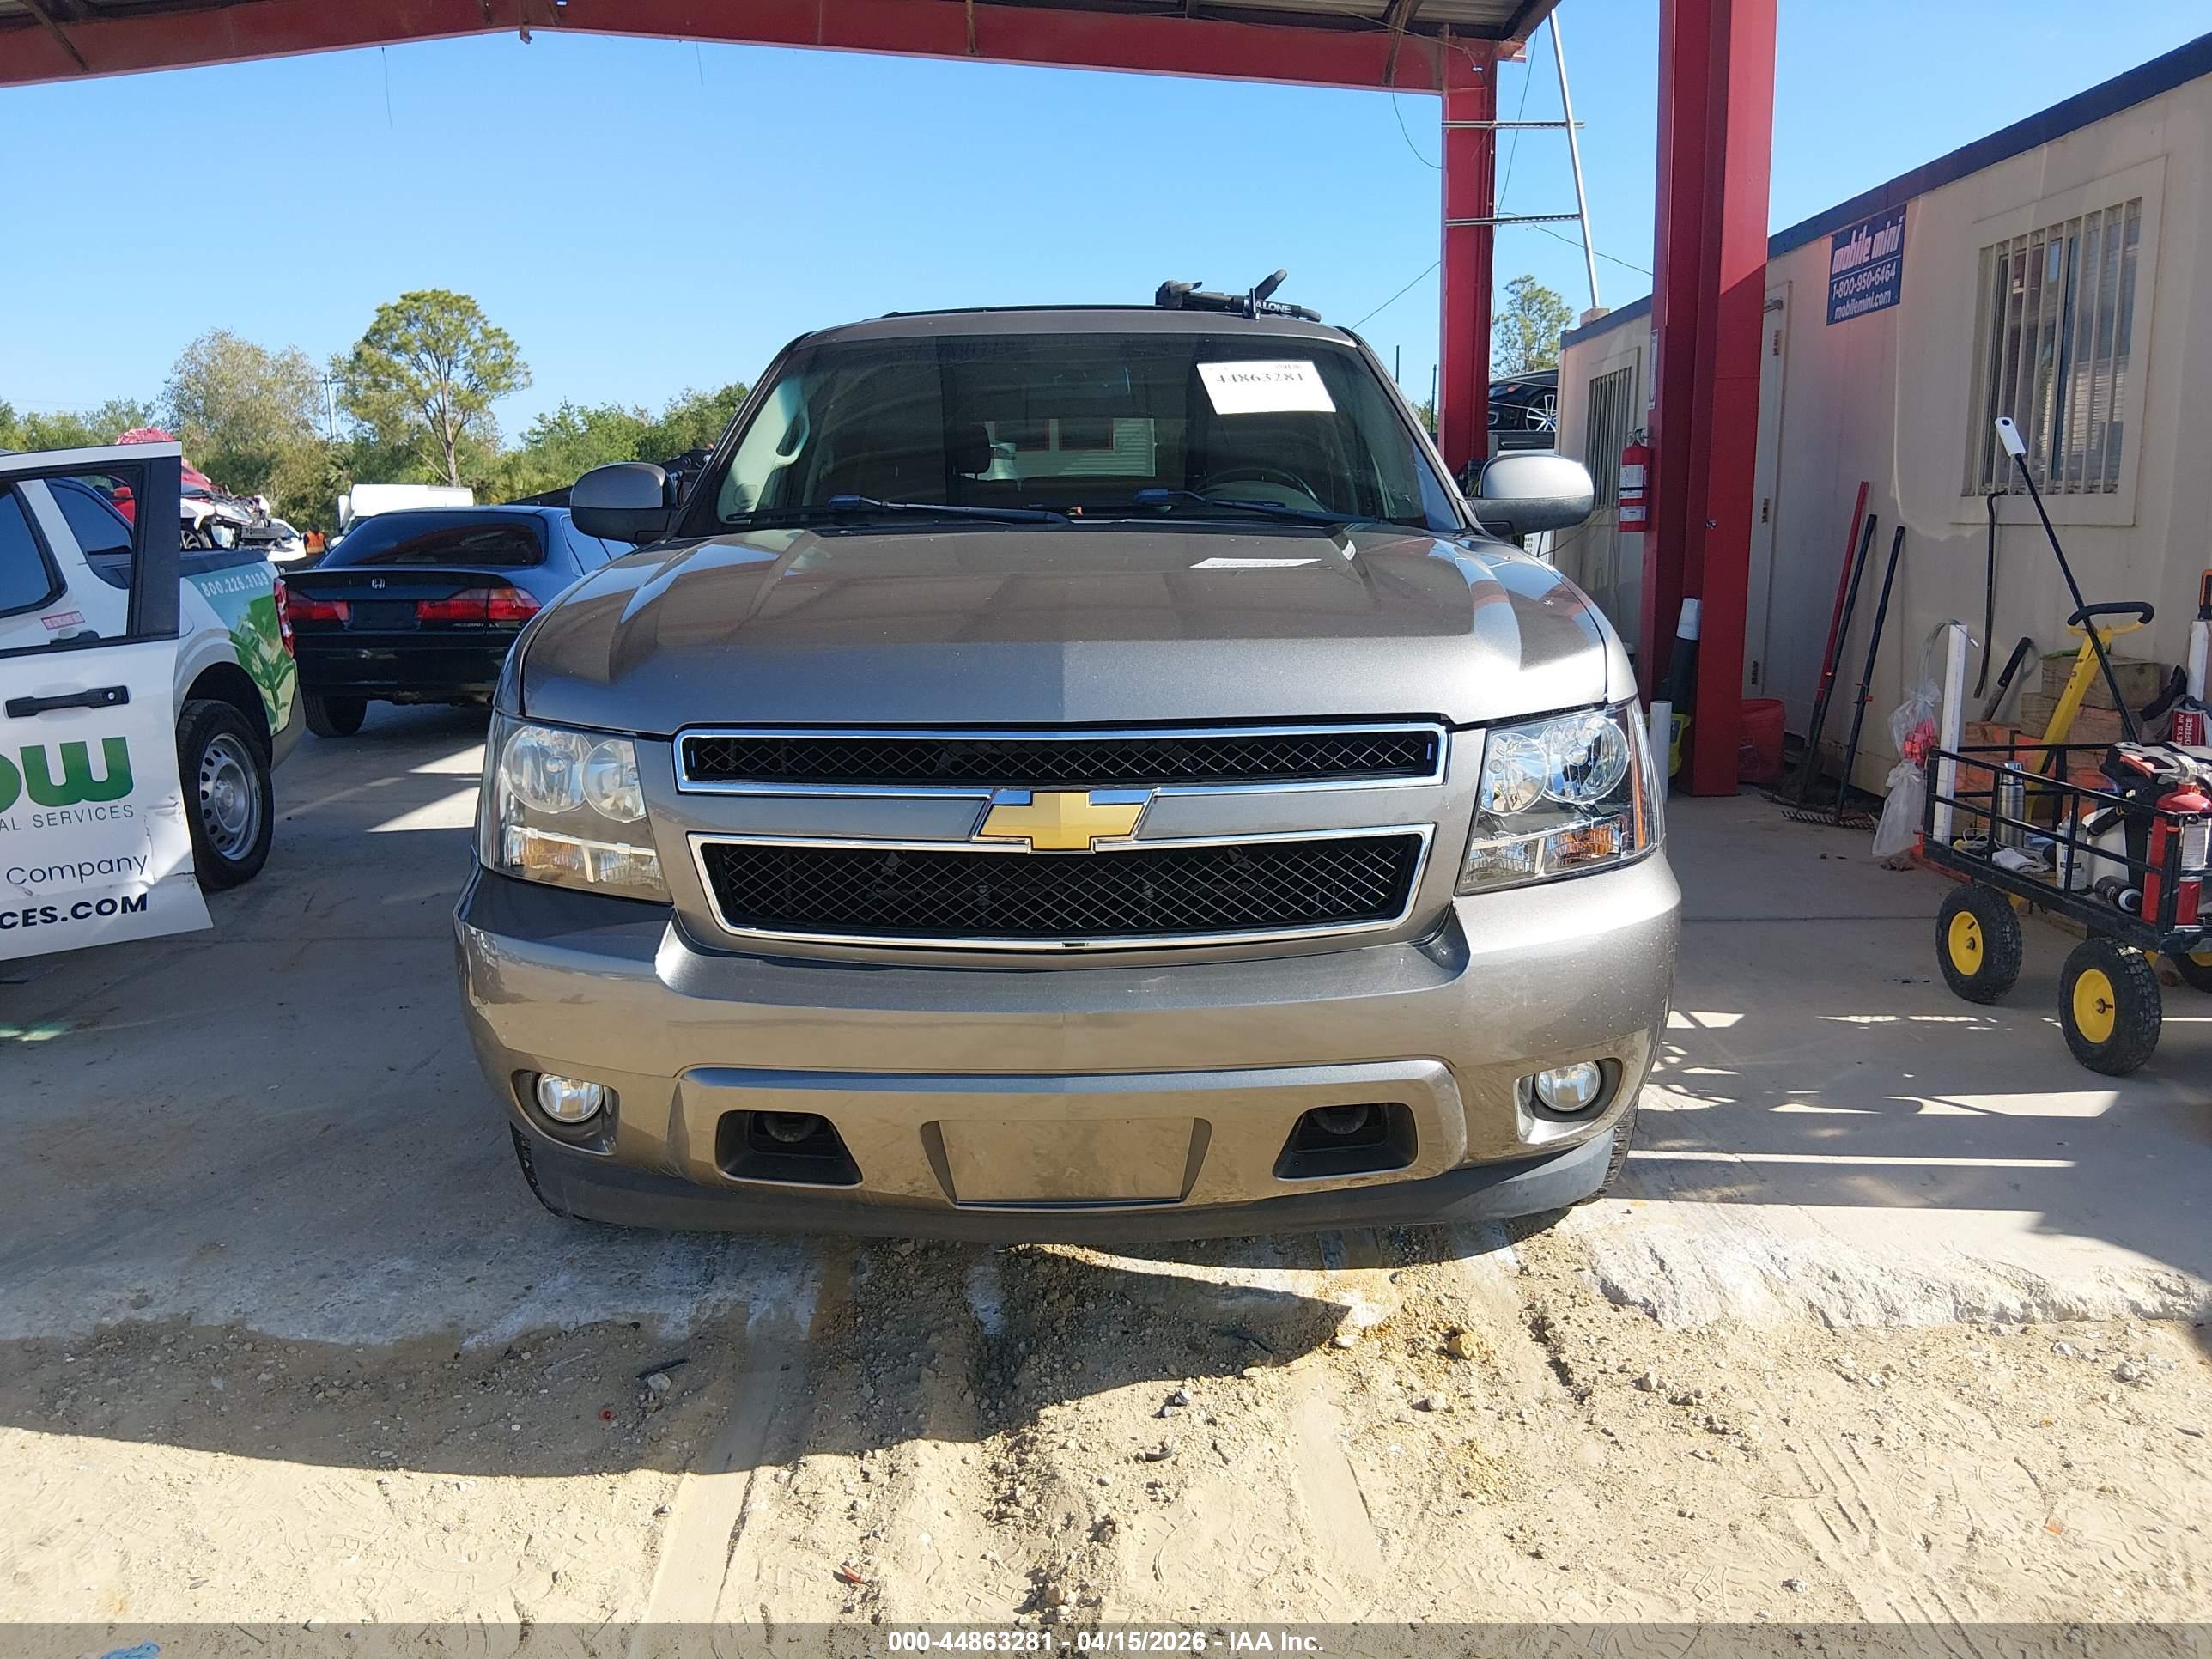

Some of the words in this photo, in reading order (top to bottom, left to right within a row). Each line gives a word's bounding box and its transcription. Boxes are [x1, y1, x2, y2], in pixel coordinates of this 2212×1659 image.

[1832, 225, 1872, 275] mobile
[1871, 215, 1905, 259] mini
[1832, 261, 1896, 301] 1-800-950-6464
[1834, 290, 1891, 320] mobilemini.com
[1216, 373, 1304, 383] 44863281
[201, 571, 269, 598] 800.226.3139
[2185, 716, 2193, 746] OFFICE
[32, 805, 134, 829] SERVICES
[6, 854, 148, 884] Company
[0, 893, 148, 930] CES.COM
